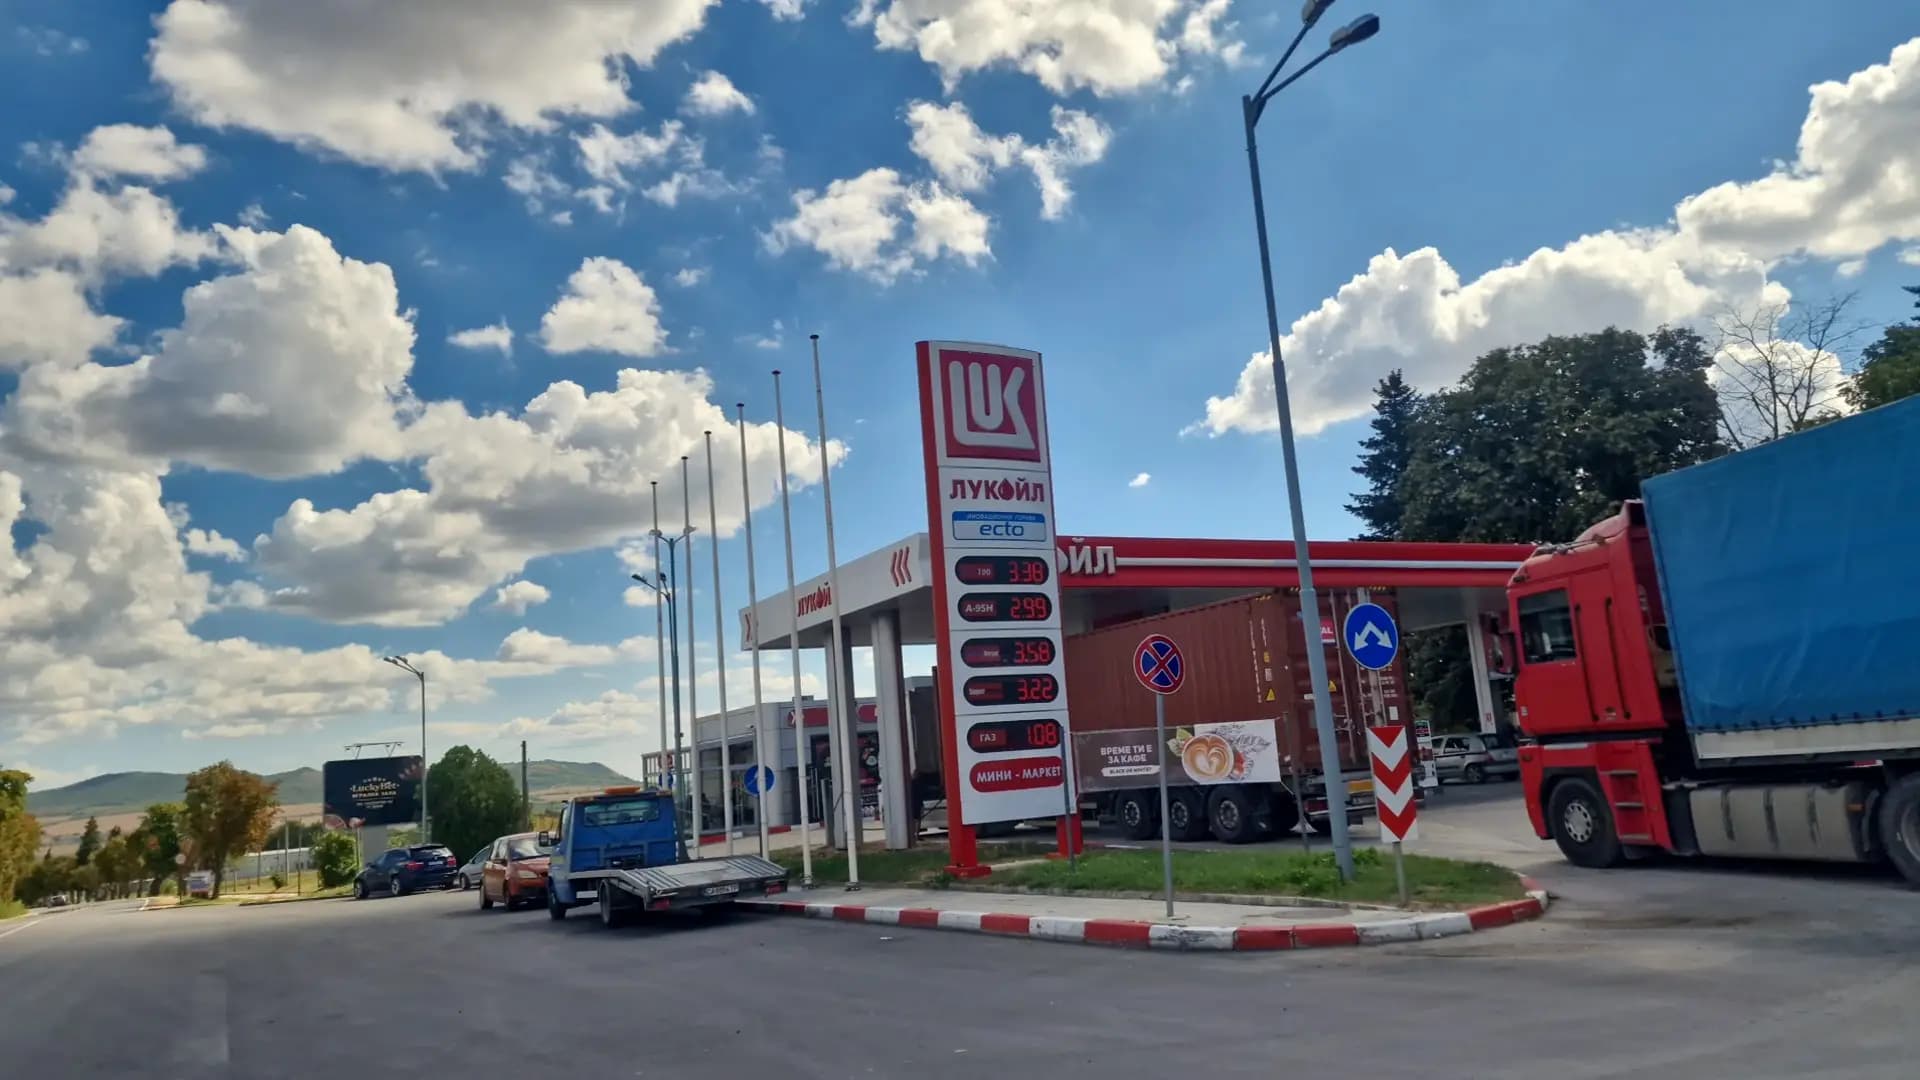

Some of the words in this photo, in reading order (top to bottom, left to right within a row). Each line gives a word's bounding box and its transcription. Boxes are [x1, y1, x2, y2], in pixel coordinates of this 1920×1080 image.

[950, 477, 1045, 502] ЛУКОЙЛ
[979, 521, 1024, 537] ecto
[977, 567, 991, 577] 100
[1014, 640, 1050, 664] 3.58
[979, 732, 997, 743] ГАЗ
[1100, 745, 1131, 756] ВРЕМЕ
[1132, 744, 1145, 754] ТИ
[1146, 744, 1153, 753] Е
[1107, 755, 1120, 764] ЗА
[1121, 753, 1147, 763] КАФЕ
[976, 769, 1012, 783] МИНИ
[1022, 766, 1061, 780] МАРКЕТ
